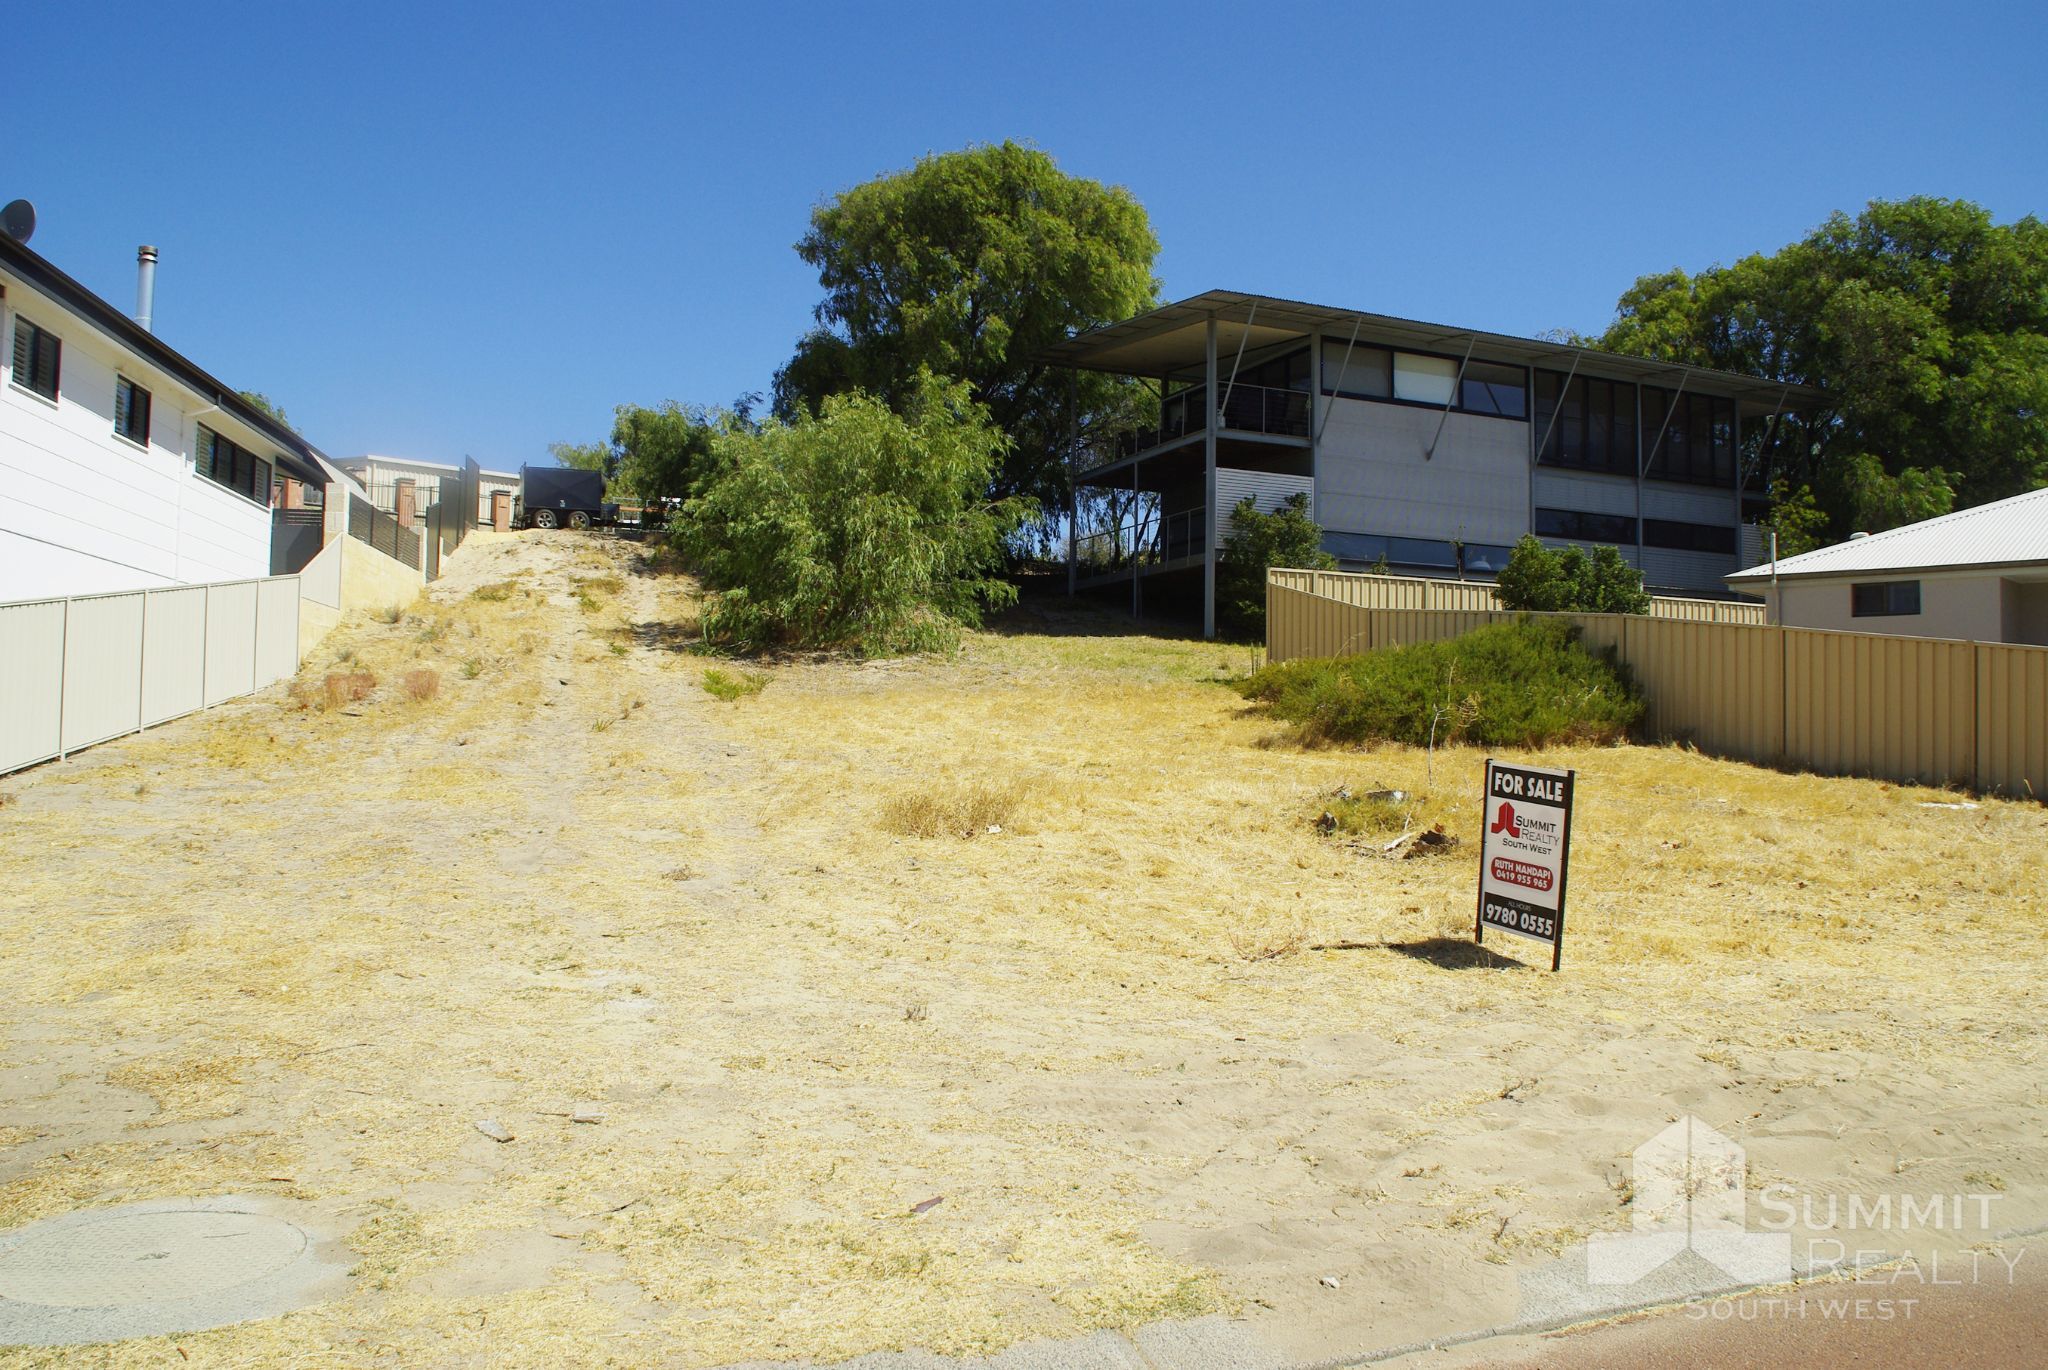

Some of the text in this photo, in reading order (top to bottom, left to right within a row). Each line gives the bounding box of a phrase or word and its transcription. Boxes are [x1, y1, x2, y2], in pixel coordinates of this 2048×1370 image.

[1494, 772, 1564, 802] FOR SALE
[1515, 815, 1557, 833] SUMMIT
[1521, 828, 1560, 846] REALTY
[1502, 838, 1552, 855] SOUTH WEST
[1494, 859, 1514, 872] RUTH
[1496, 870, 1548, 889] 0419 955 965
[1486, 903, 1554, 936] 9780 0555
